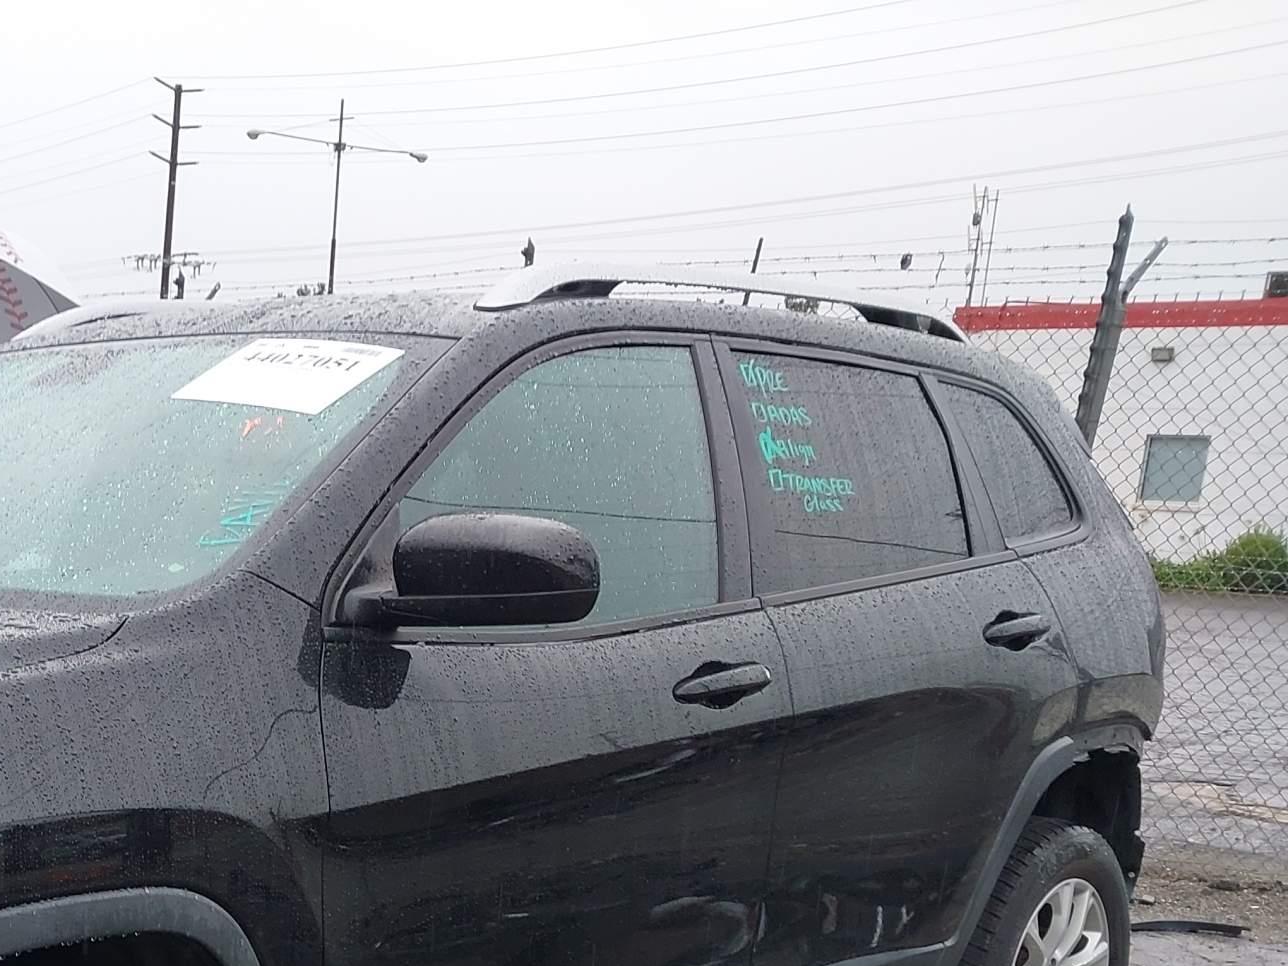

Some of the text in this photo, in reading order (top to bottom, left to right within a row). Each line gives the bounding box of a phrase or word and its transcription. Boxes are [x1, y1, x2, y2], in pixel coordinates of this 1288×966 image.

[244, 350, 361, 371] 44027051
[768, 405, 812, 427] ADAS
[782, 472, 855, 497] TRANSFER
